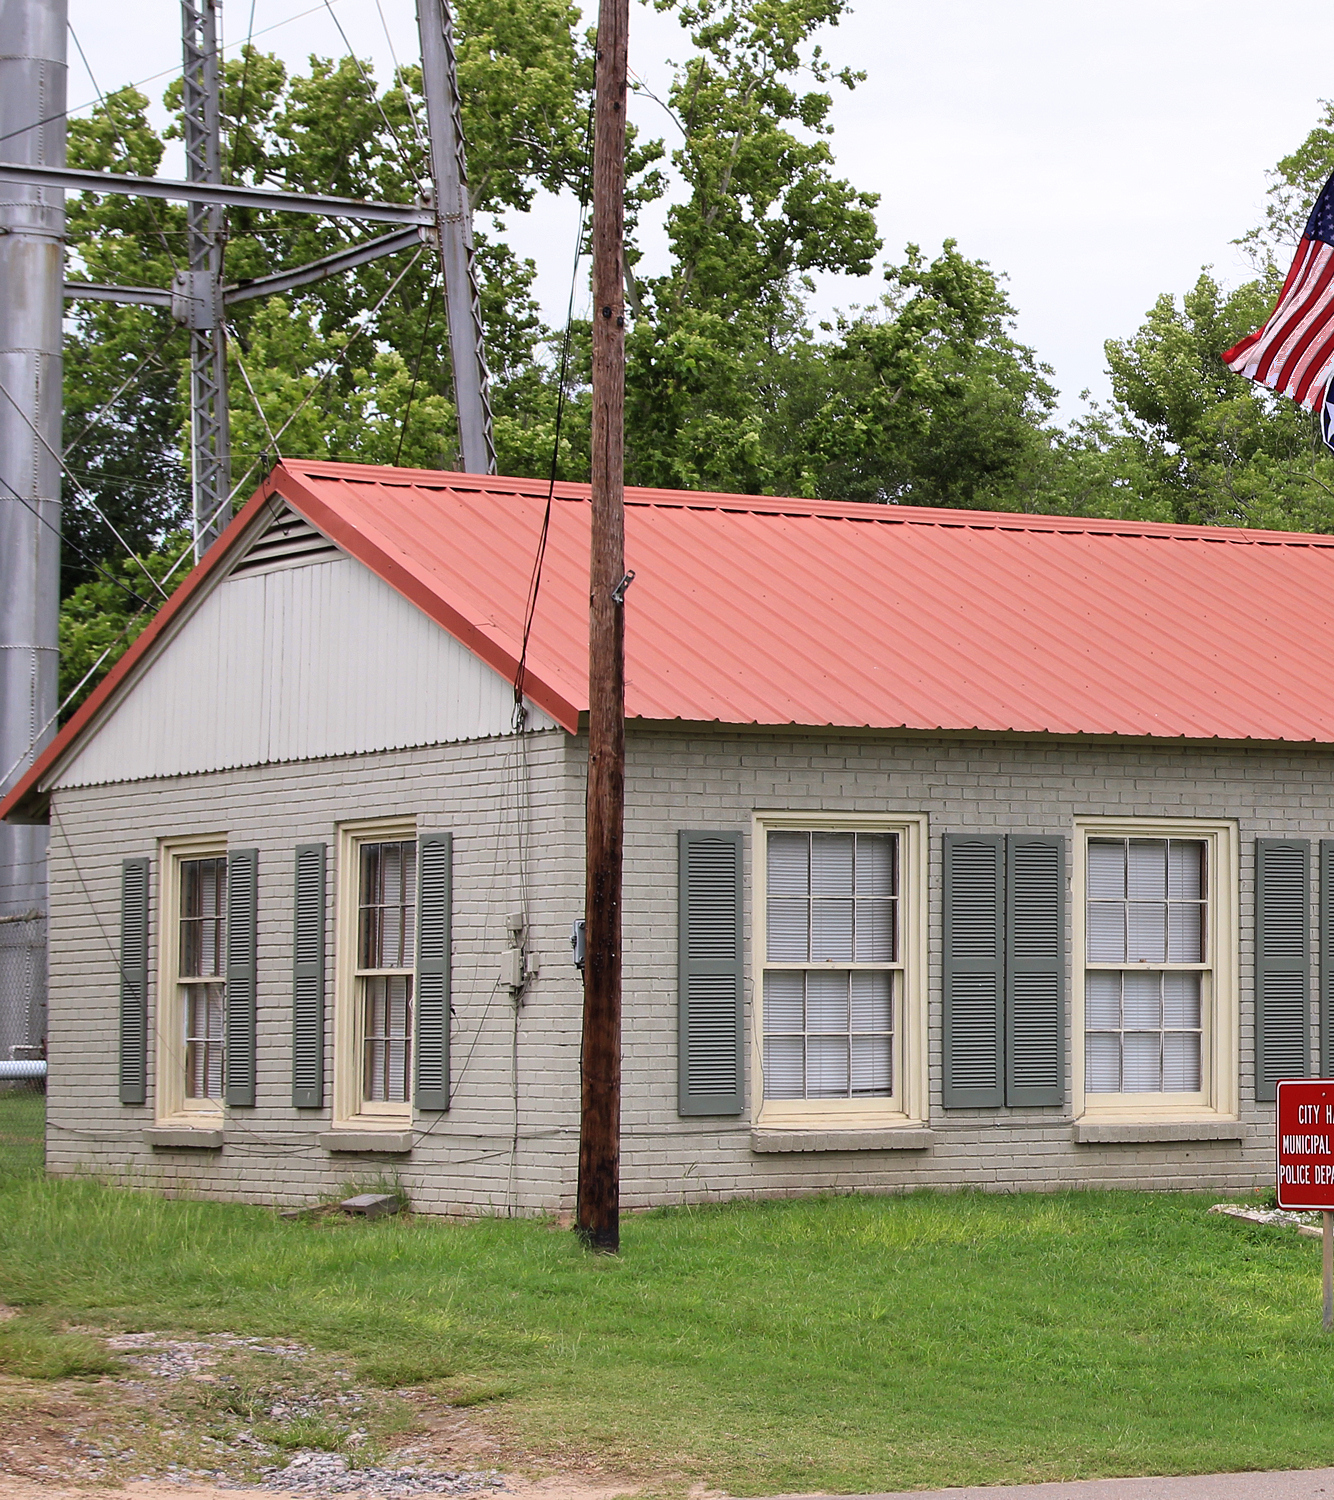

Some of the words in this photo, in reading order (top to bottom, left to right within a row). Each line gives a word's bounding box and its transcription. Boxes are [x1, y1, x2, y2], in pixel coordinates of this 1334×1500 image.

[1298, 1104, 1320, 1125] CITY
[1282, 1135, 1331, 1155] MUNICIPAL
[1280, 1164, 1311, 1185] POLICE
